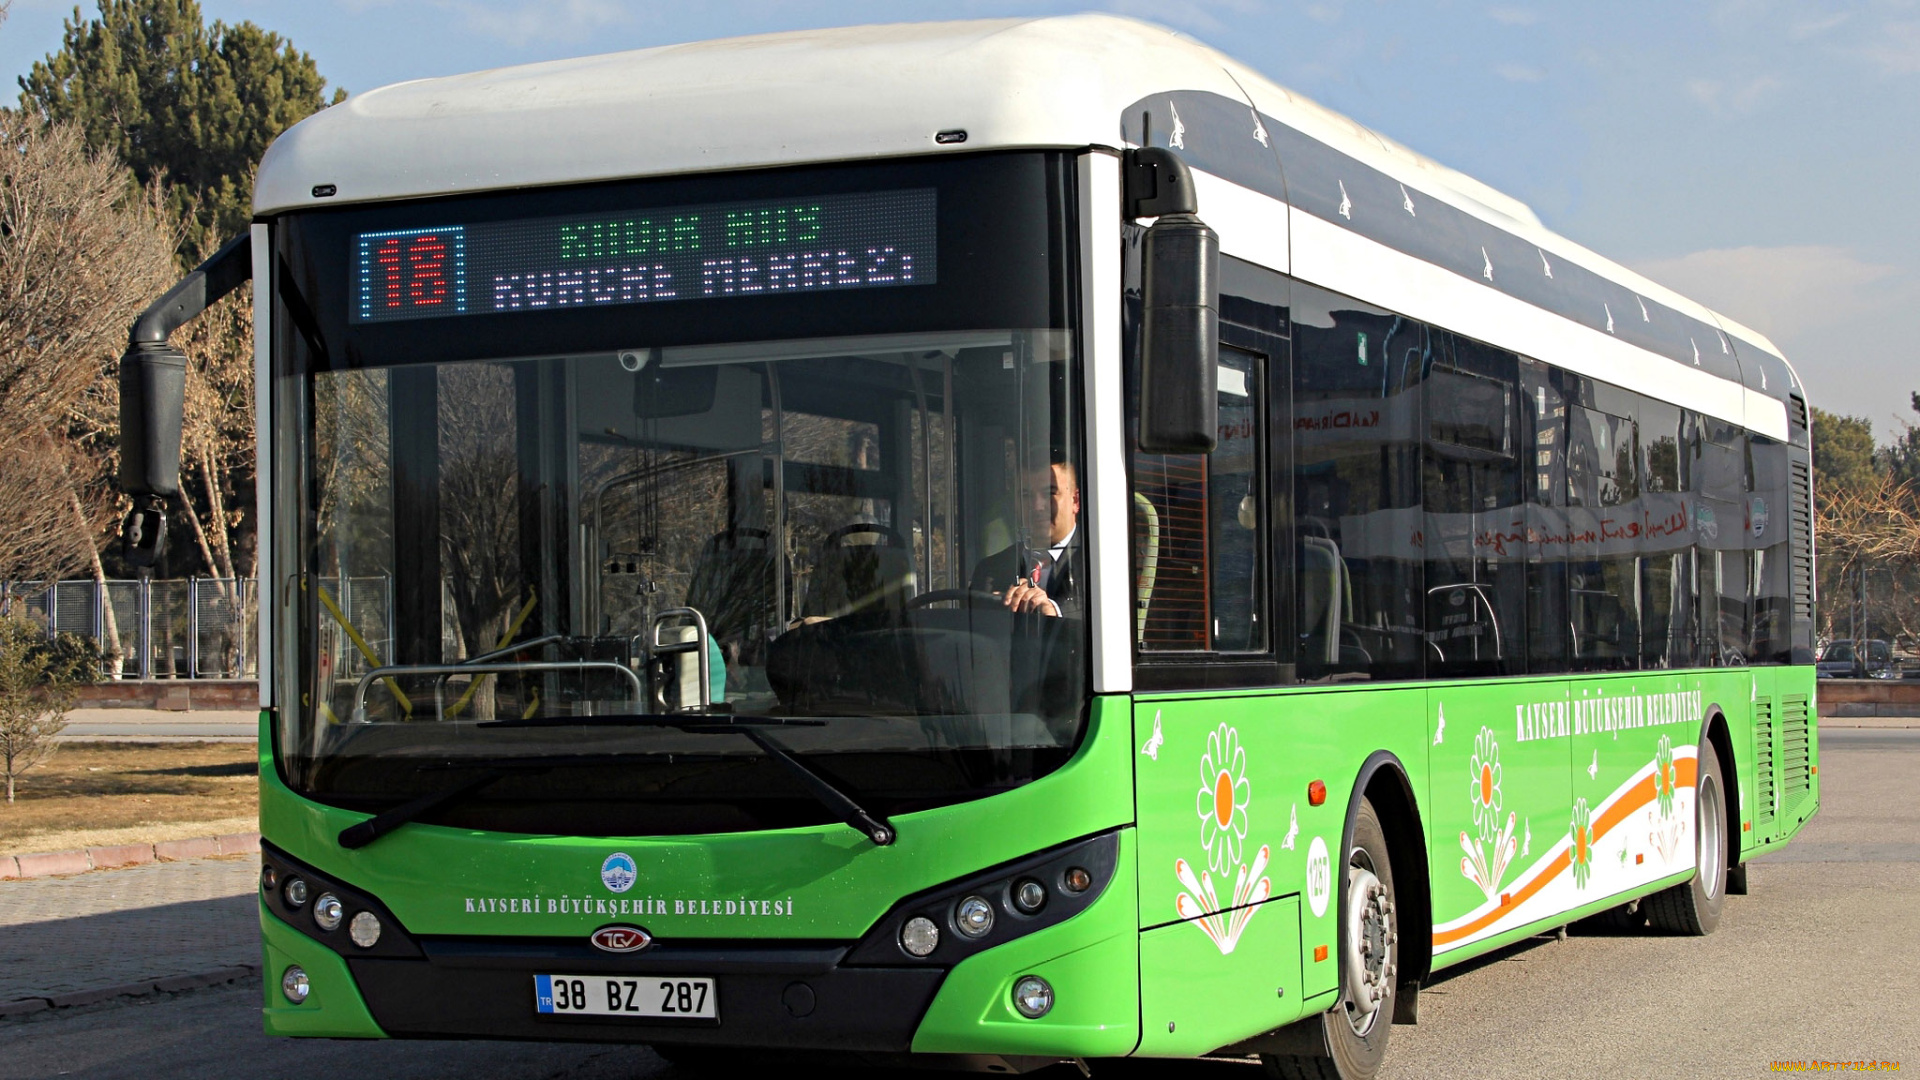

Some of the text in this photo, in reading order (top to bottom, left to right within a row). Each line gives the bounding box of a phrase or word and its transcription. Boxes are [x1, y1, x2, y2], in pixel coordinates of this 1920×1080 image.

[379, 237, 445, 307] 18
[1516, 680, 1701, 742] KAYSERİ BÜYÜKŞEHİR BELEDİYESİ
[1308, 855, 1328, 897] 1287
[465, 894, 794, 918] KAYSERİ BÜYÜKŞEHİR BELEDİYESİ
[540, 979, 708, 1013] TR 38 BZ 287
